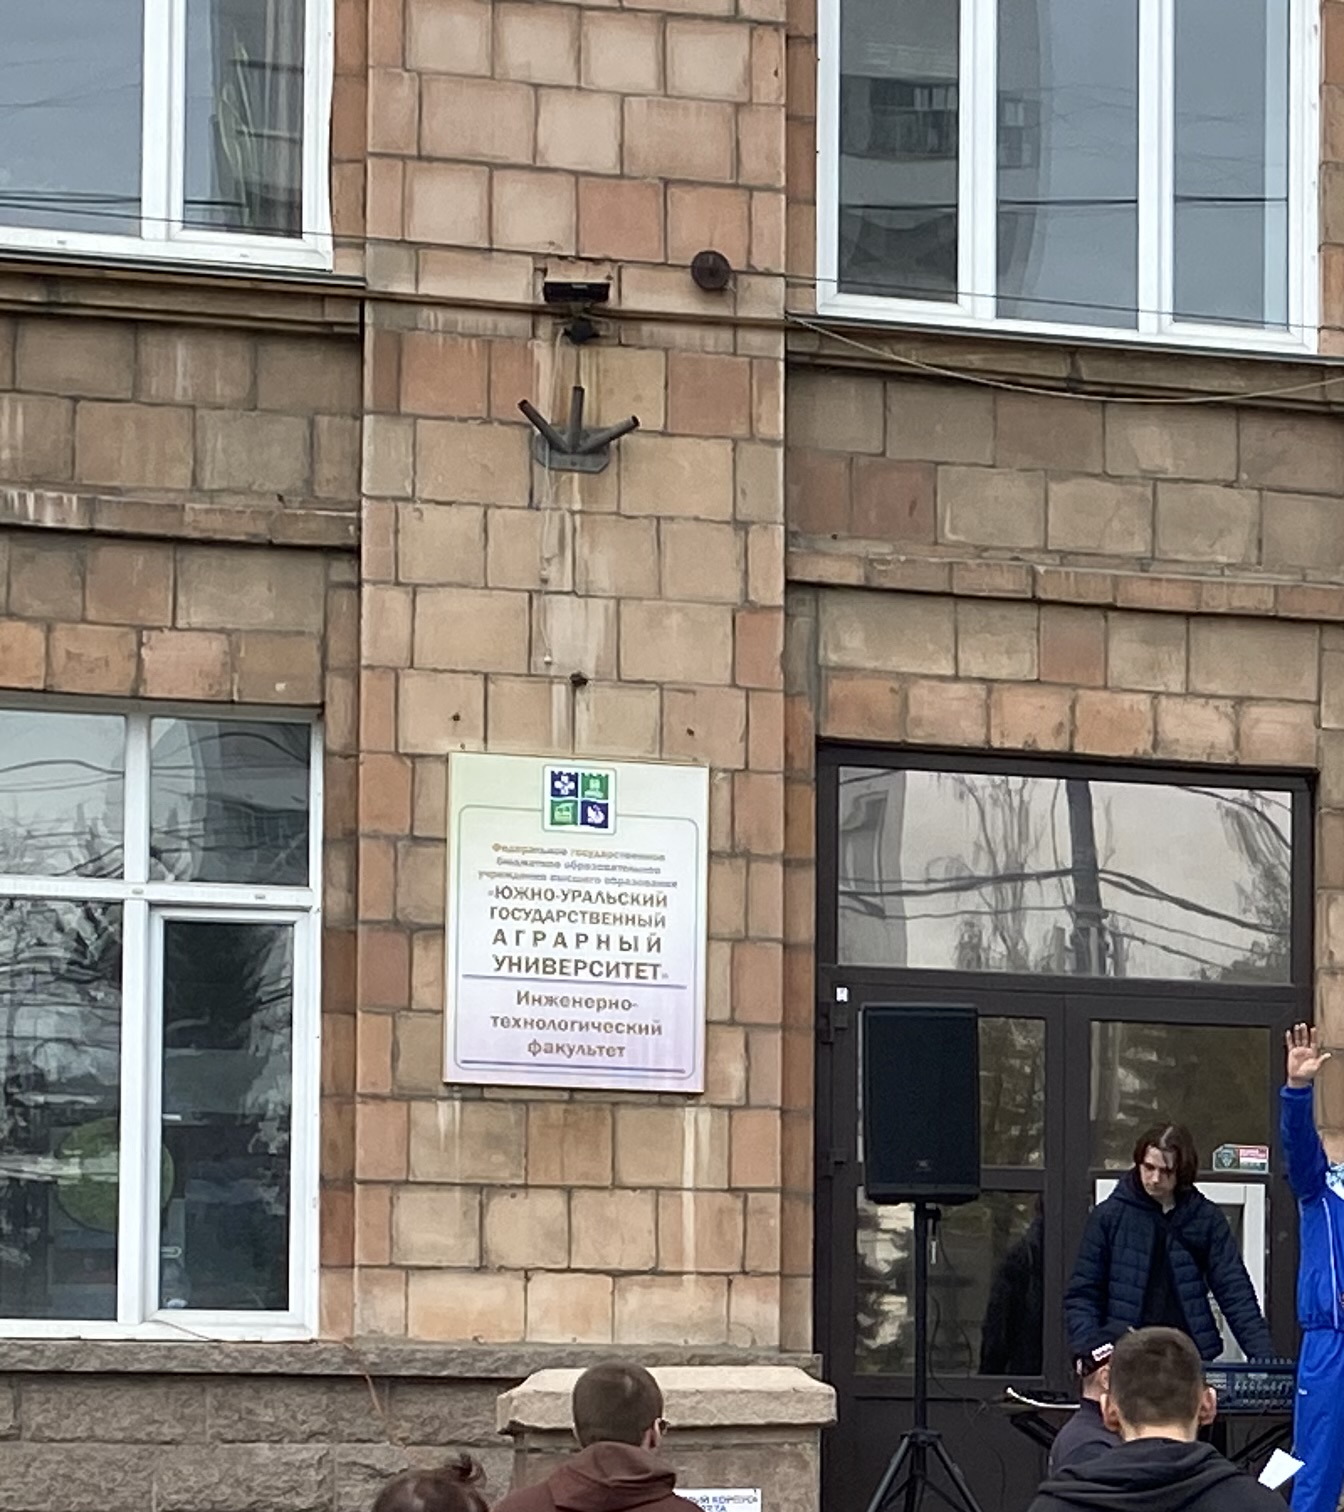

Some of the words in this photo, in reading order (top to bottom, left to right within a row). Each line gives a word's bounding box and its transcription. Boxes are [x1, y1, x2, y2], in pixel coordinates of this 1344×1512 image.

[489, 906, 667, 928] ГОСУДАРСТВЕННЫЙ
[492, 928, 662, 953] АГРАРНЫЙ
[516, 989, 639, 1013] Инженерно-
[490, 1014, 663, 1036] технологический
[527, 1038, 626, 1058] факультет
